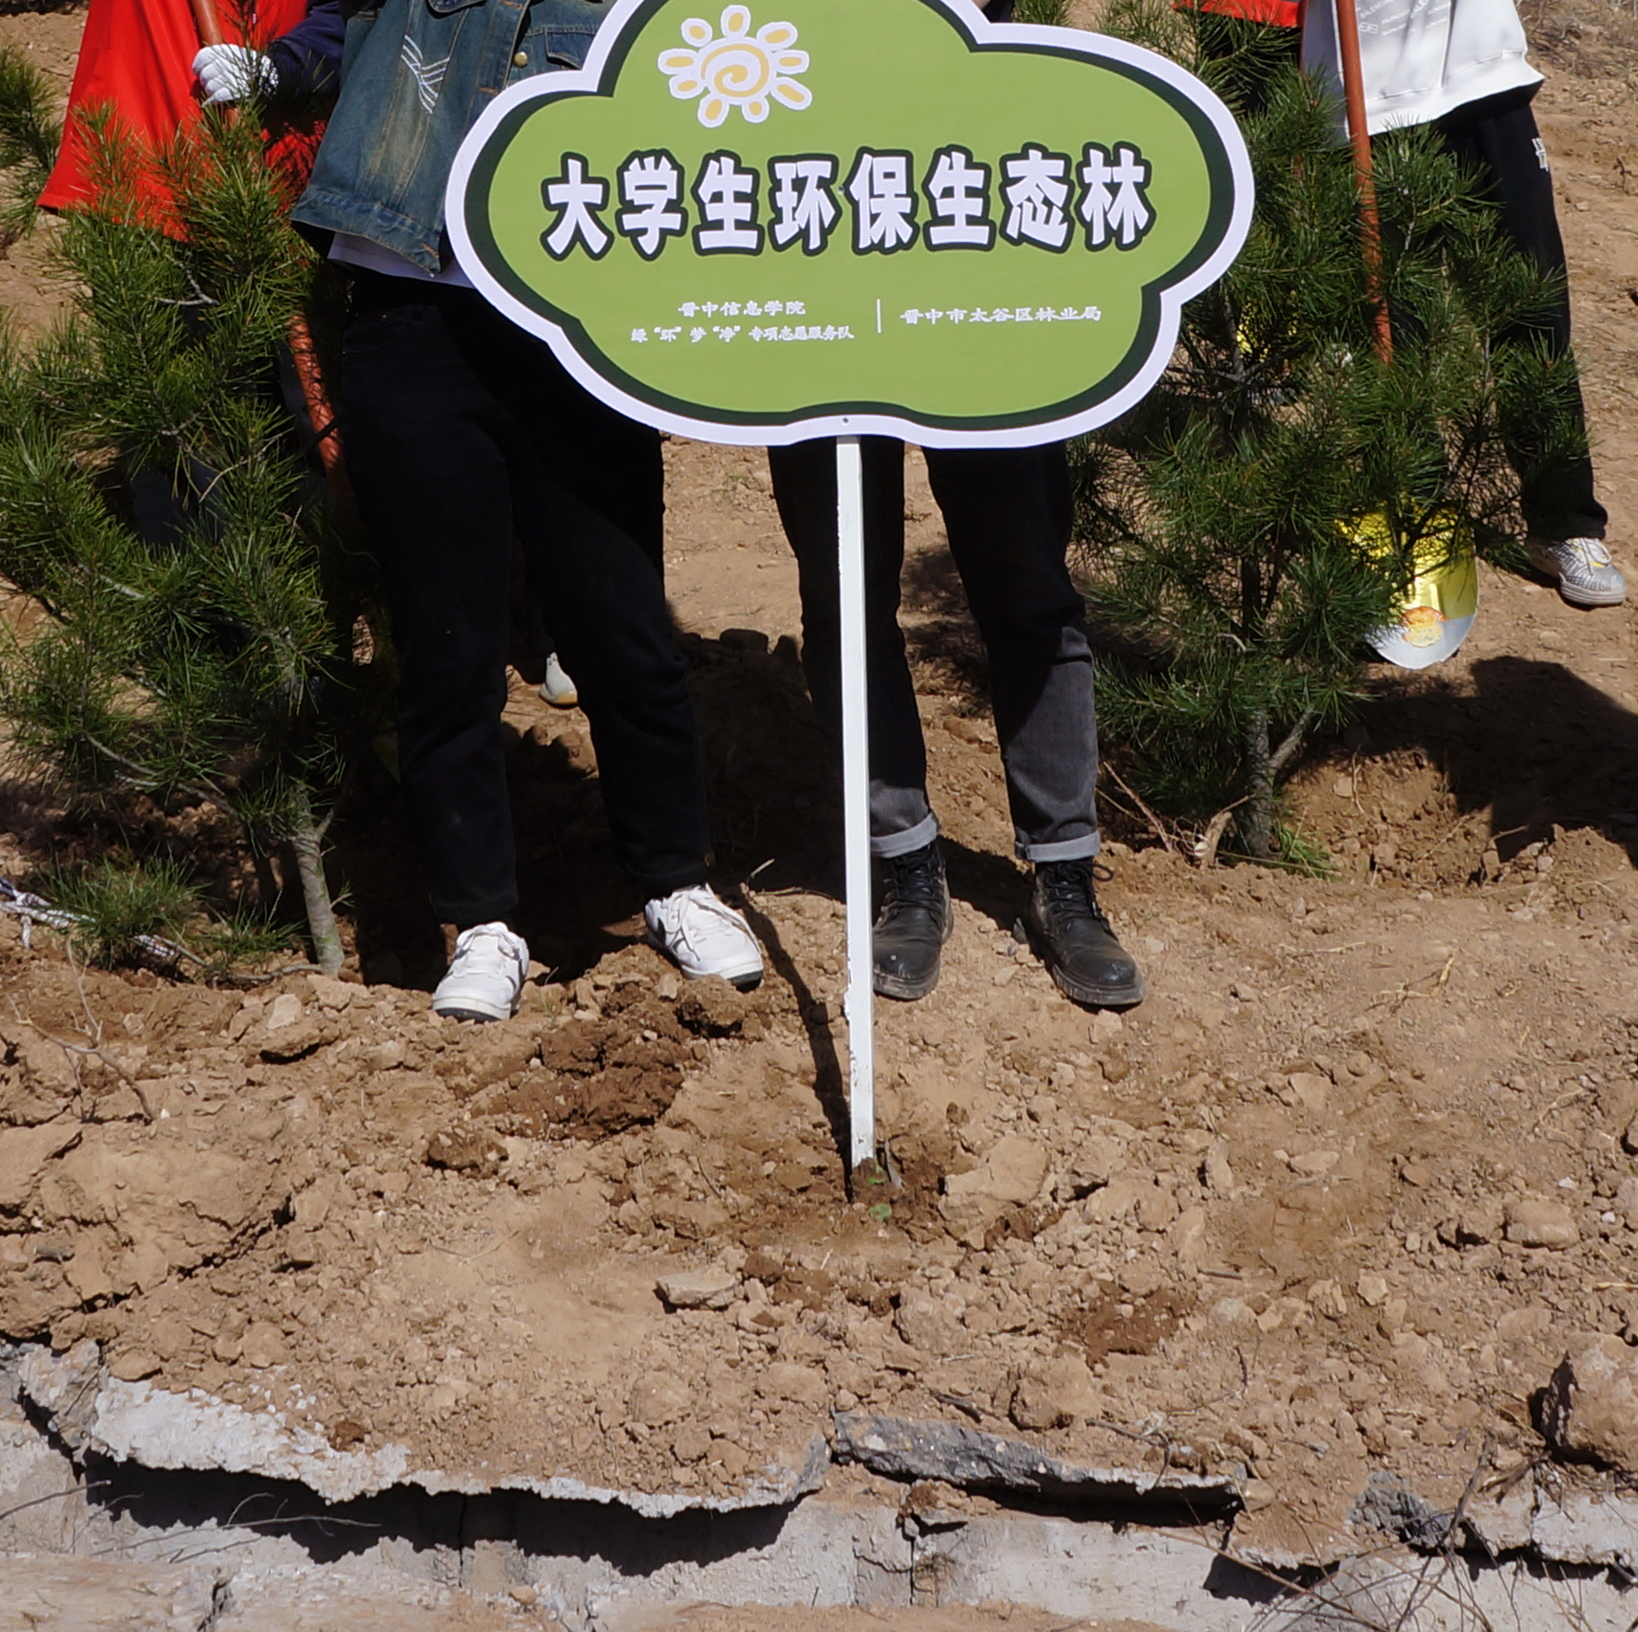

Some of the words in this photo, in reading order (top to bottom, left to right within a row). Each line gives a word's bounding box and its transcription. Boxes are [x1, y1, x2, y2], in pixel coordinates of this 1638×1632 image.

[543, 147, 1152, 257] 大学生环保生态林
[678, 300, 806, 318] 晋中信息学院
[899, 306, 1103, 325] 晋中市太谷区林业局
